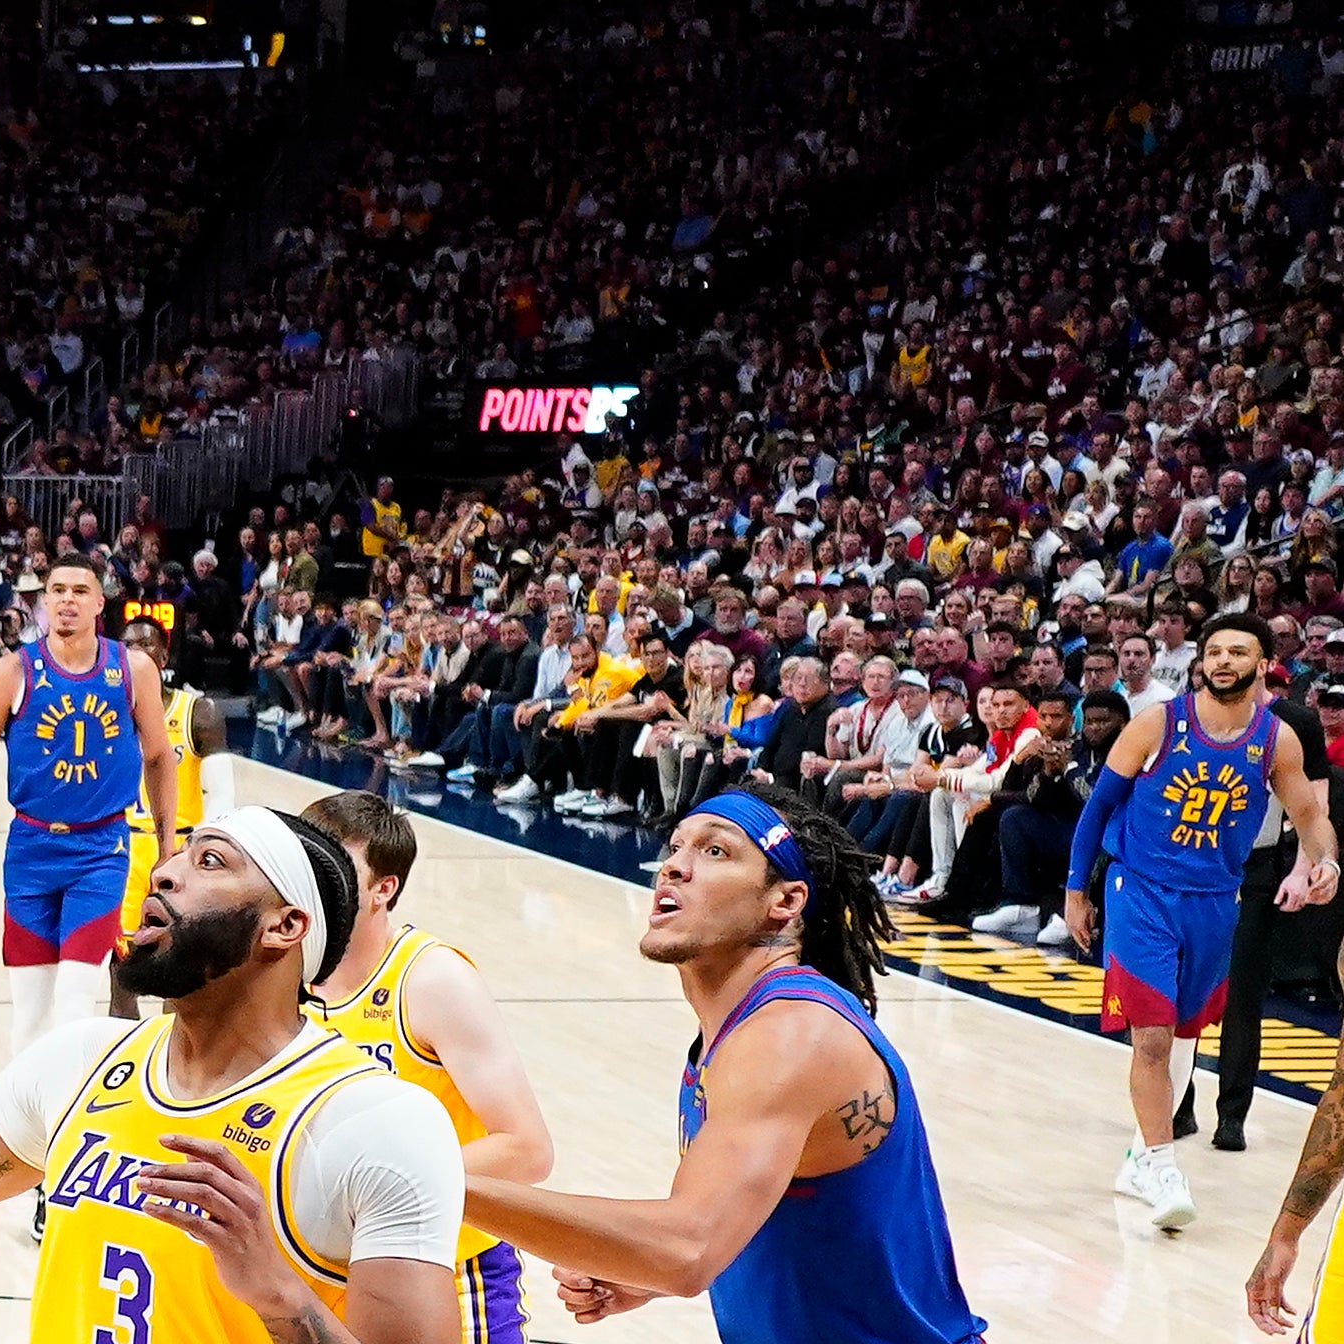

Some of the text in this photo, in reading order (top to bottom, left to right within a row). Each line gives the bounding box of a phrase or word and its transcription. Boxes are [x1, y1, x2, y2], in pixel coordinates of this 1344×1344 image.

[479, 387, 641, 434] POINTSBE
[36, 692, 120, 740] MILE HIGH
[74, 720, 85, 757] 1
[53, 759, 99, 784] CITY
[1162, 761, 1250, 812] MILE HIGH
[1180, 786, 1230, 826] 27
[1170, 823, 1219, 850] CITY
[106, 1064, 131, 1088] 6
[222, 1123, 271, 1152] bibigo
[48, 1132, 211, 1221] LAK
